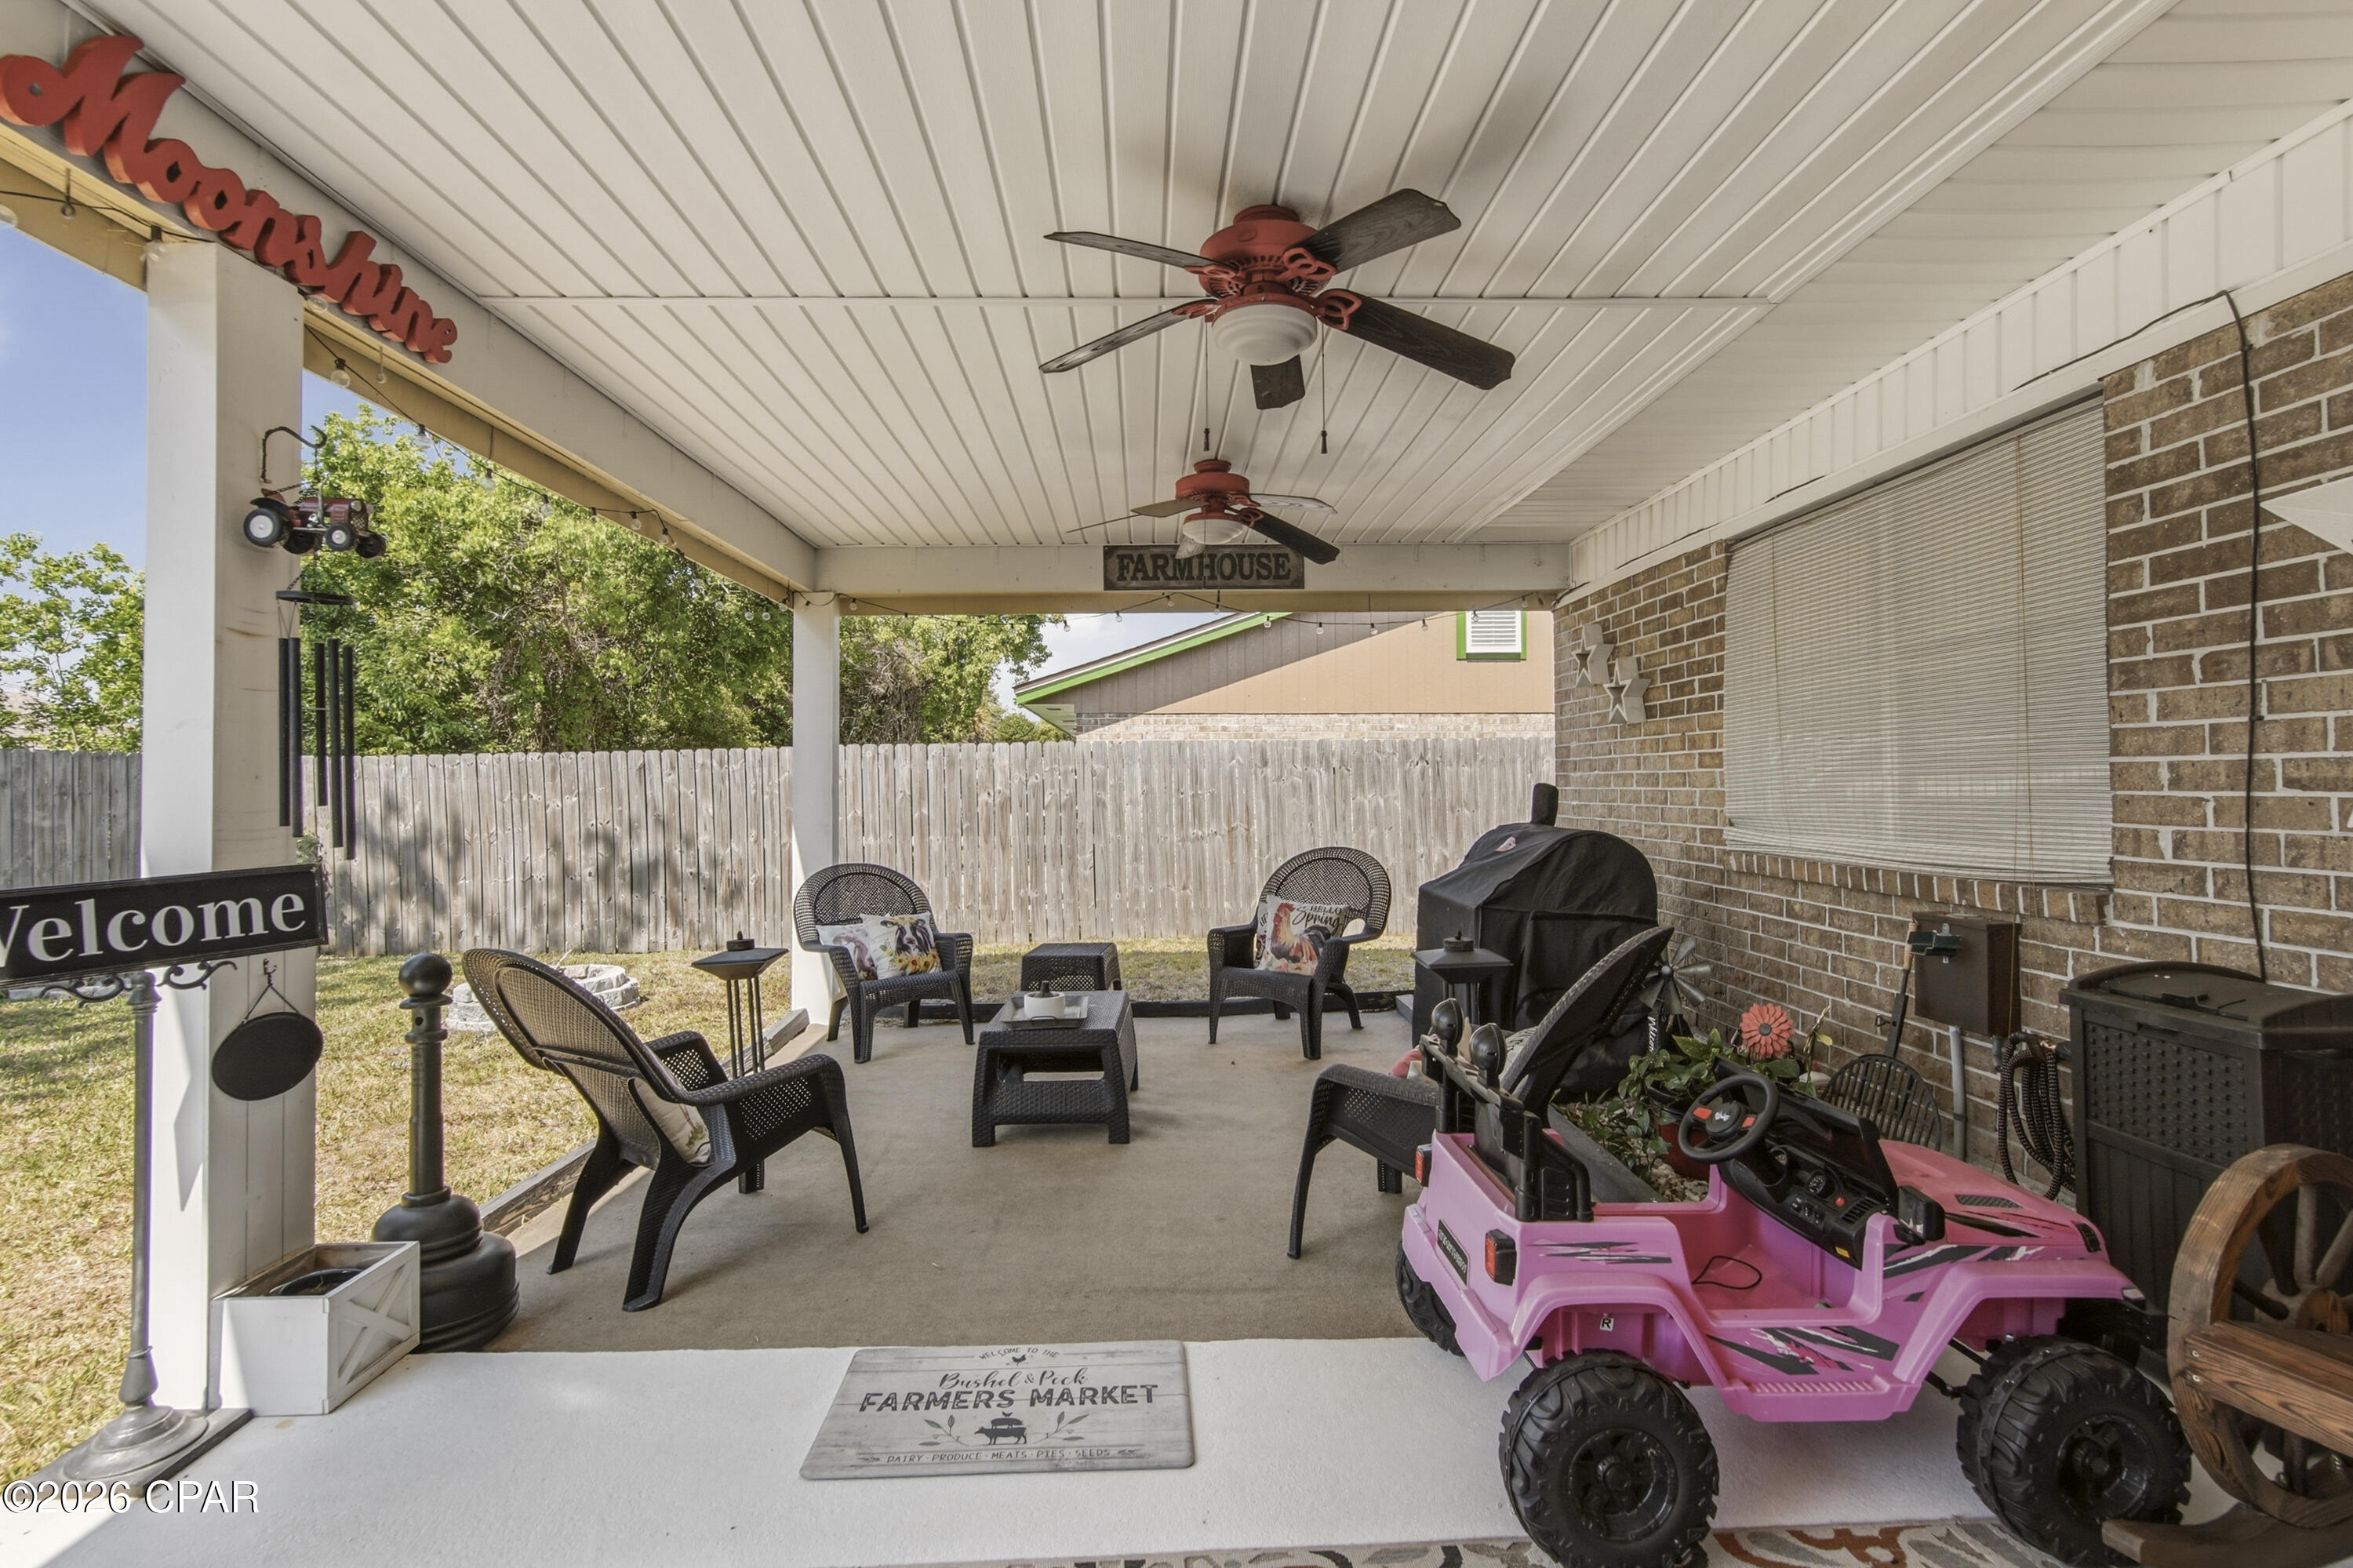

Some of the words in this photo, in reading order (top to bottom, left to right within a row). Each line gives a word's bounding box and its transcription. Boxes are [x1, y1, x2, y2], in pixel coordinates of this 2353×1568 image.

[0, 35, 458, 364] Moonshine
[1116, 552, 1293, 582] FARMHOUSE
[1292, 906, 1344, 937] Spring
[1310, 905, 1342, 916] HELLO
[1601, 1318, 1612, 1330] R
[979, 1348, 1020, 1360] WELCOME
[1042, 1349, 1060, 1359] THE
[939, 1369, 1023, 1390] Bushel
[1038, 1367, 1089, 1386] Peck
[859, 1389, 1016, 1412] FARMERS
[1029, 1384, 1158, 1407] MARKET
[886, 1454, 924, 1464] DAIRY
[932, 1452, 983, 1462] PRODUCE
[991, 1451, 1027, 1460] MEATS
[1036, 1450, 1065, 1458] PIES
[1075, 1448, 1111, 1457] SEEDS
